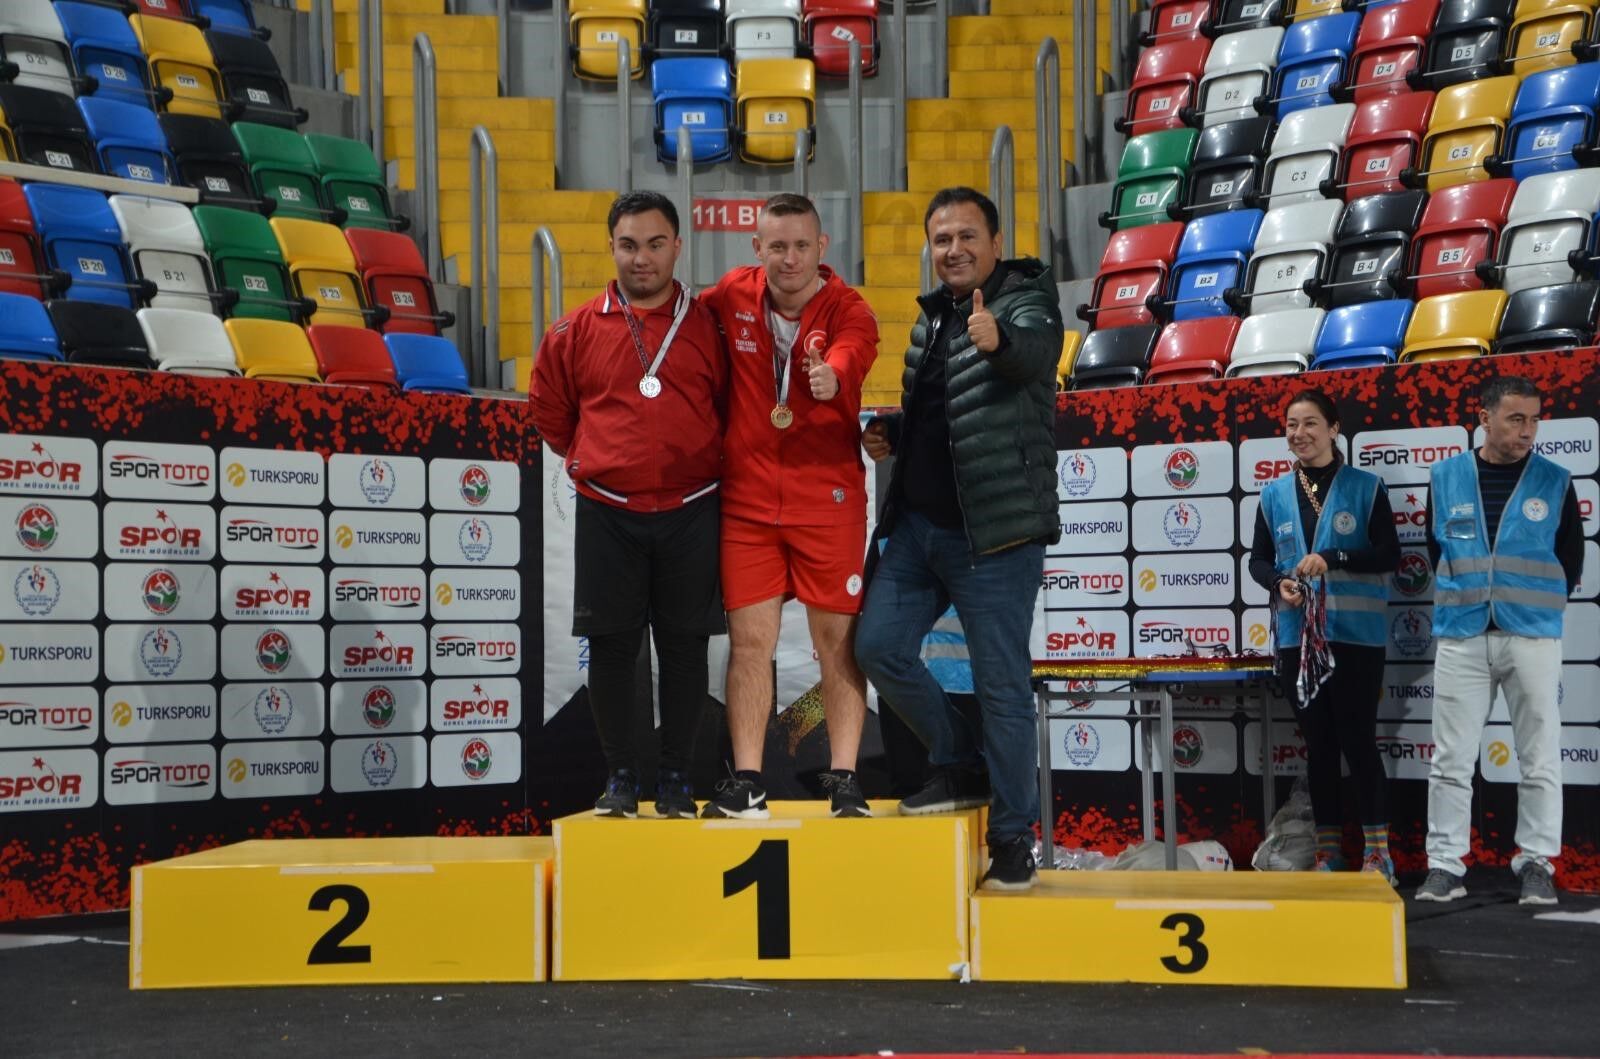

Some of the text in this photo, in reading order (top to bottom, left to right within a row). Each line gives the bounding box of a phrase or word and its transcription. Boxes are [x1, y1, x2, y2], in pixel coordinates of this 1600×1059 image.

[693, 205, 732, 225] 111.
[0, 459, 81, 482] SPOR
[250, 470, 319, 485] TURKSPORU
[120, 527, 201, 548] SPOR
[1059, 521, 1122, 535] TURKSPORU
[357, 532, 421, 545] TURKSPORU
[1160, 573, 1229, 587] TURKSPORU
[236, 589, 311, 609] SPOR
[456, 588, 516, 601] TURKSPORU
[1046, 632, 1116, 651] SPOR
[9, 646, 93, 662] TURKSPORU
[344, 646, 414, 667] SPOR
[137, 705, 211, 722] TURKSPORU
[443, 700, 509, 721] SPOR
[250, 761, 319, 777] TURKSPORU
[0, 774, 81, 799] SPOR
[723, 840, 791, 961] 1
[307, 884, 372, 966] 2
[1160, 912, 1209, 974] 3
